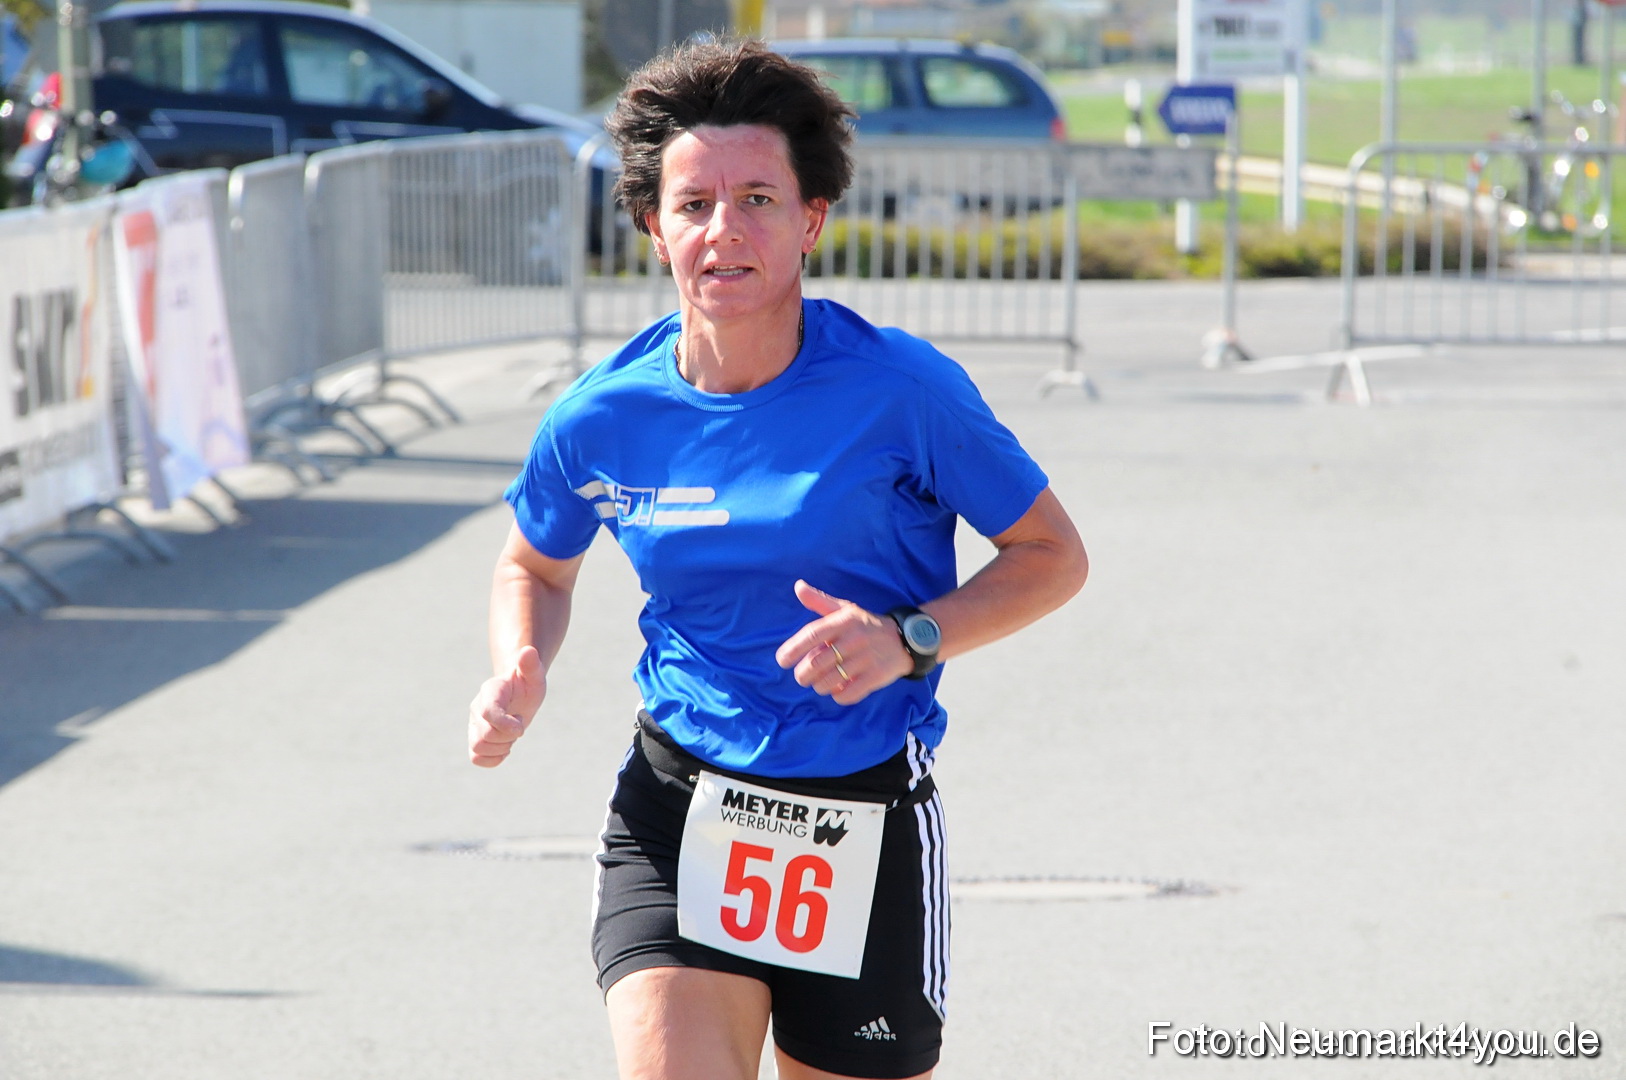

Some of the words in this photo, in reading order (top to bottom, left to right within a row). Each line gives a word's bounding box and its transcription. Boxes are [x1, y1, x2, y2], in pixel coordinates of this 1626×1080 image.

[720, 788, 809, 823] MEYER
[720, 808, 808, 838] WERBUNG
[719, 840, 834, 954] 56
[854, 1030, 897, 1041] adidas
